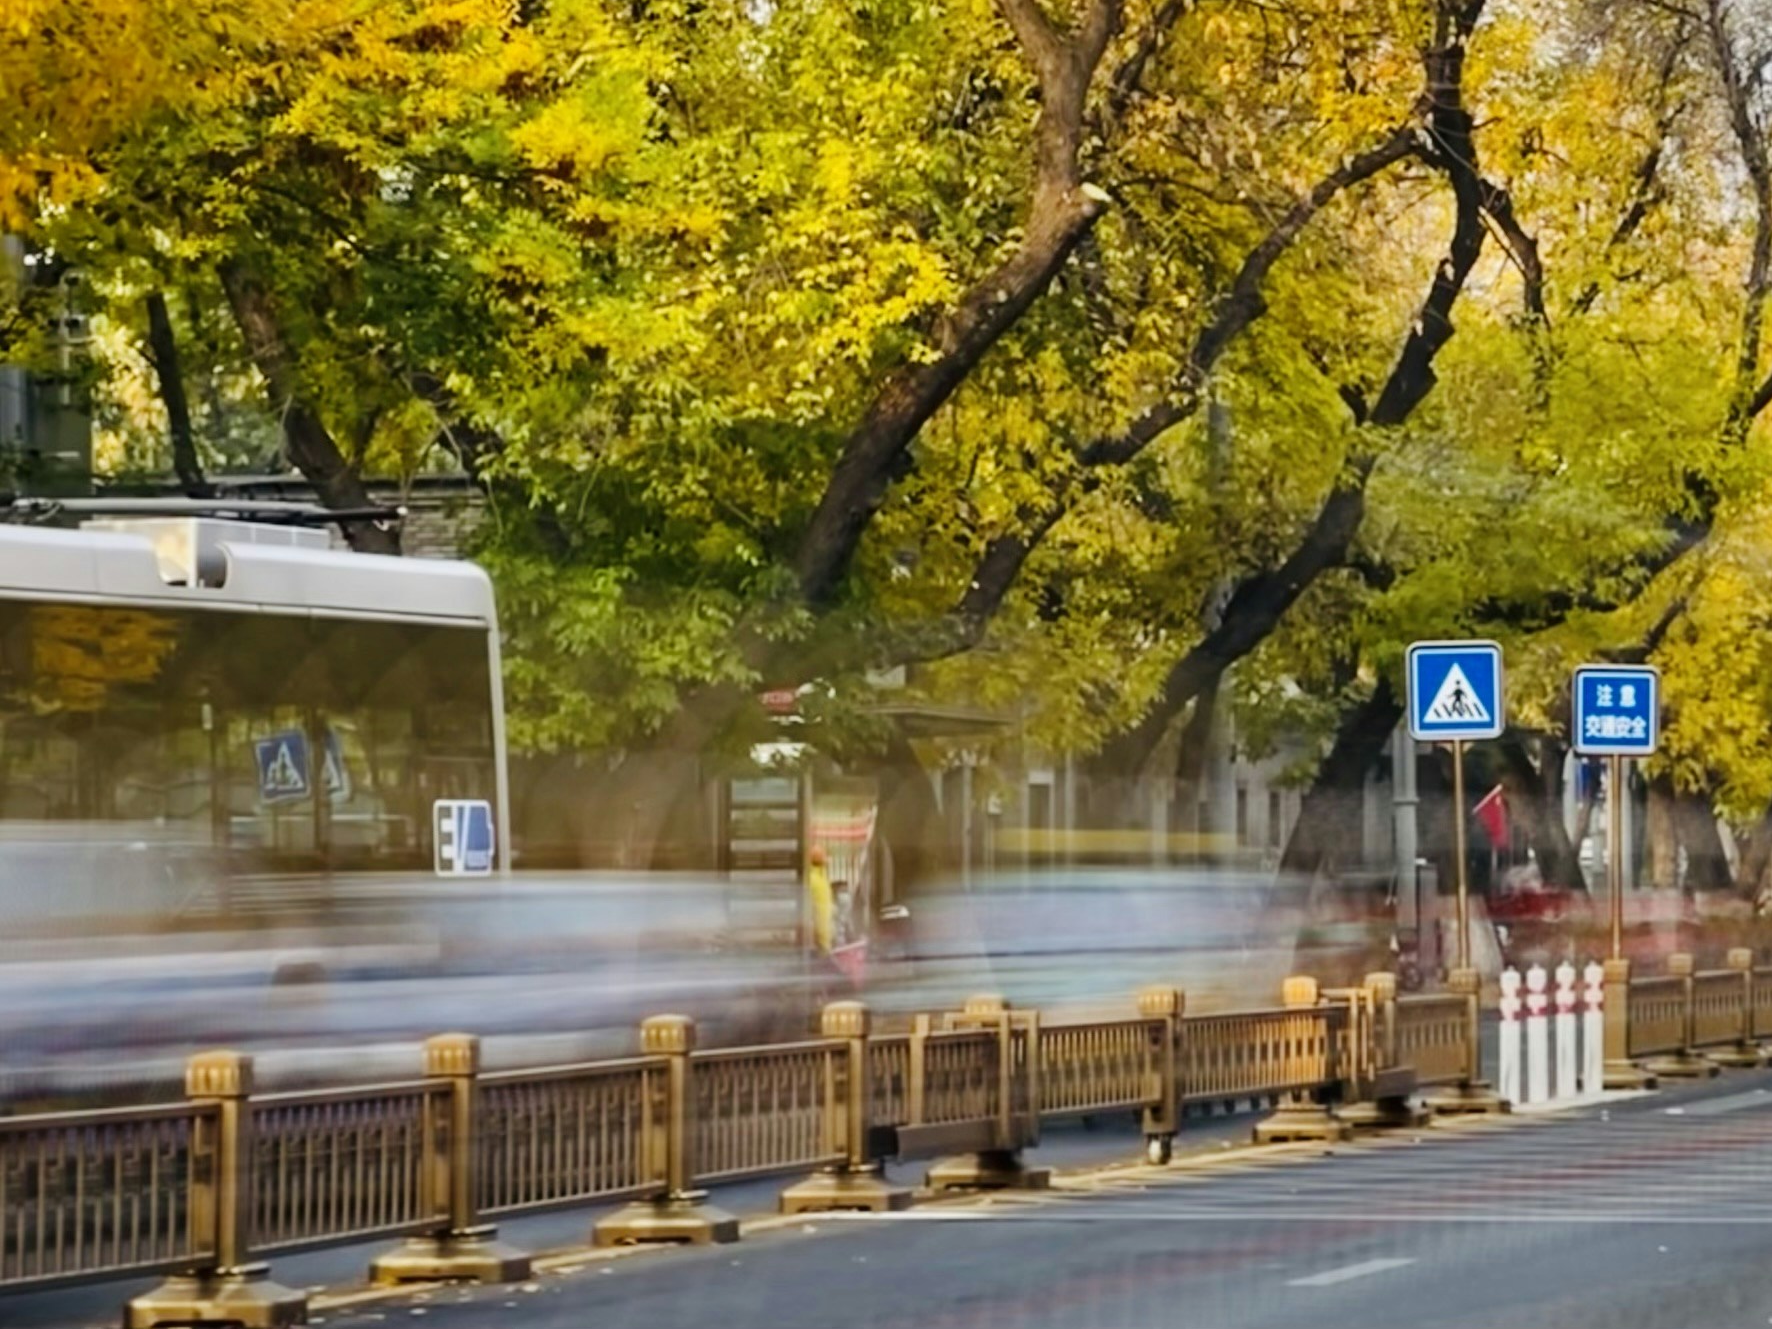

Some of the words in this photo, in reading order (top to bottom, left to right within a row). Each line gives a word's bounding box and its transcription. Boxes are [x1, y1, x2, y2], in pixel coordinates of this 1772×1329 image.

[1596, 683, 1637, 707] 注意
[1584, 714, 1647, 739] 交通安全
